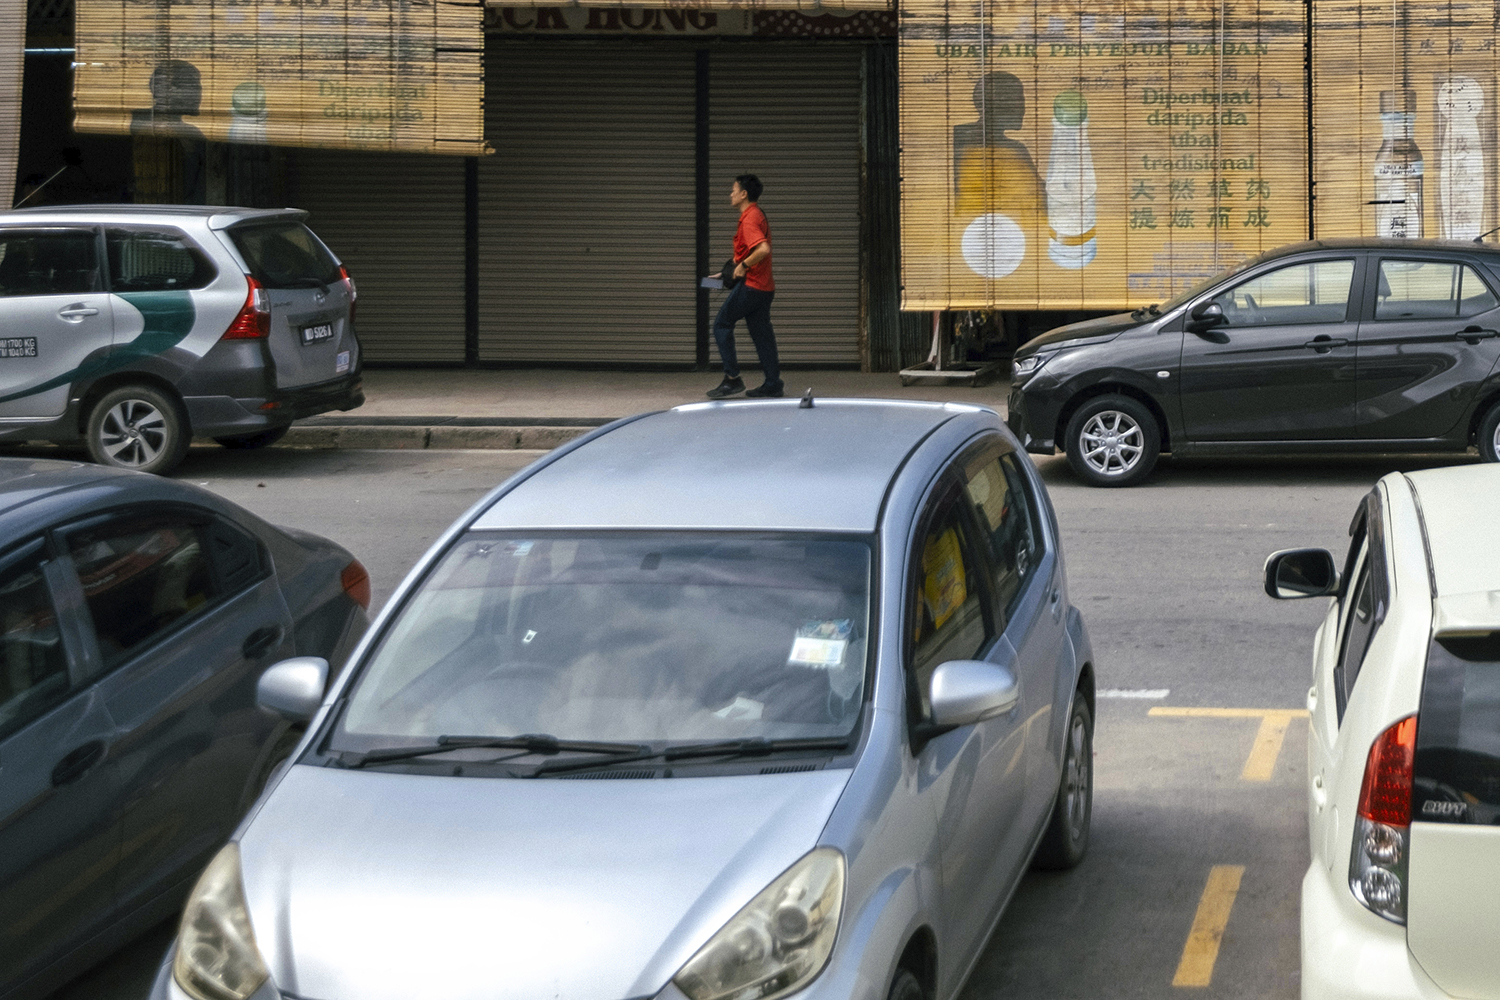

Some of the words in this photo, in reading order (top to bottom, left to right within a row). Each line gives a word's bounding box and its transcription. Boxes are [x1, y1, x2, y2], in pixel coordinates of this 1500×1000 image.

[998, 43, 1038, 57] AIR
[1142, 88, 1254, 108] Diperbuat
[1147, 108, 1249, 129] daripada
[1141, 154, 1255, 171] tradisional
[24, 338, 36, 347] KG
[25, 347, 36, 356] KG
